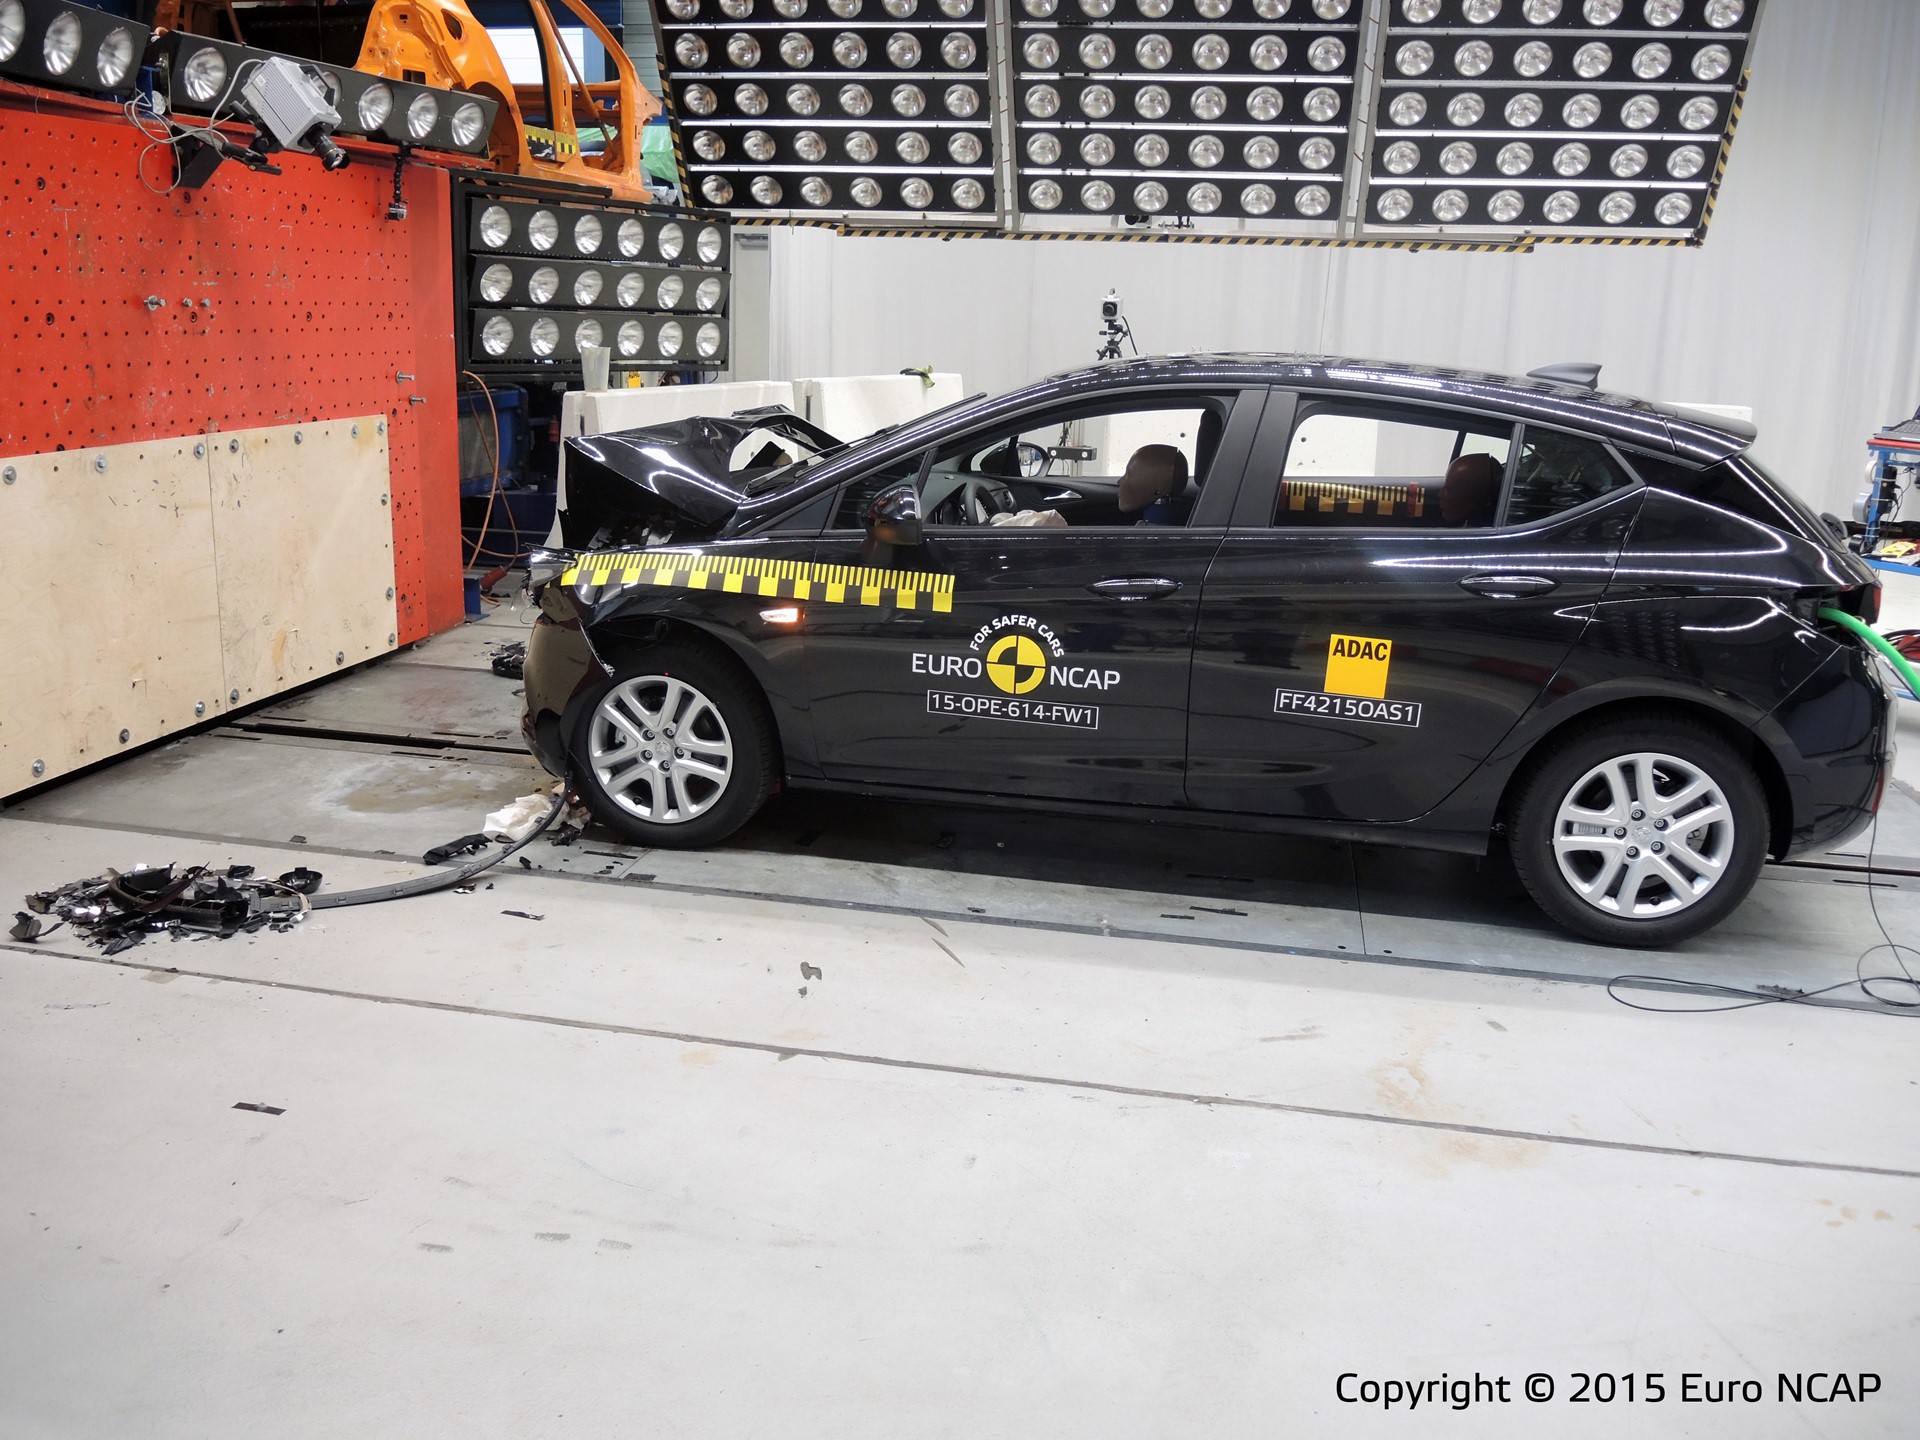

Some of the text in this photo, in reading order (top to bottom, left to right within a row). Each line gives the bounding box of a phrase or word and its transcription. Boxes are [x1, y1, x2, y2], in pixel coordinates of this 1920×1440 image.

[970, 614, 1065, 658] FOR SAFER CARS
[1332, 638, 1388, 662] ADAC
[911, 652, 1121, 690] EURO NCAP
[931, 693, 1093, 725] 15-OPE-614-FW1
